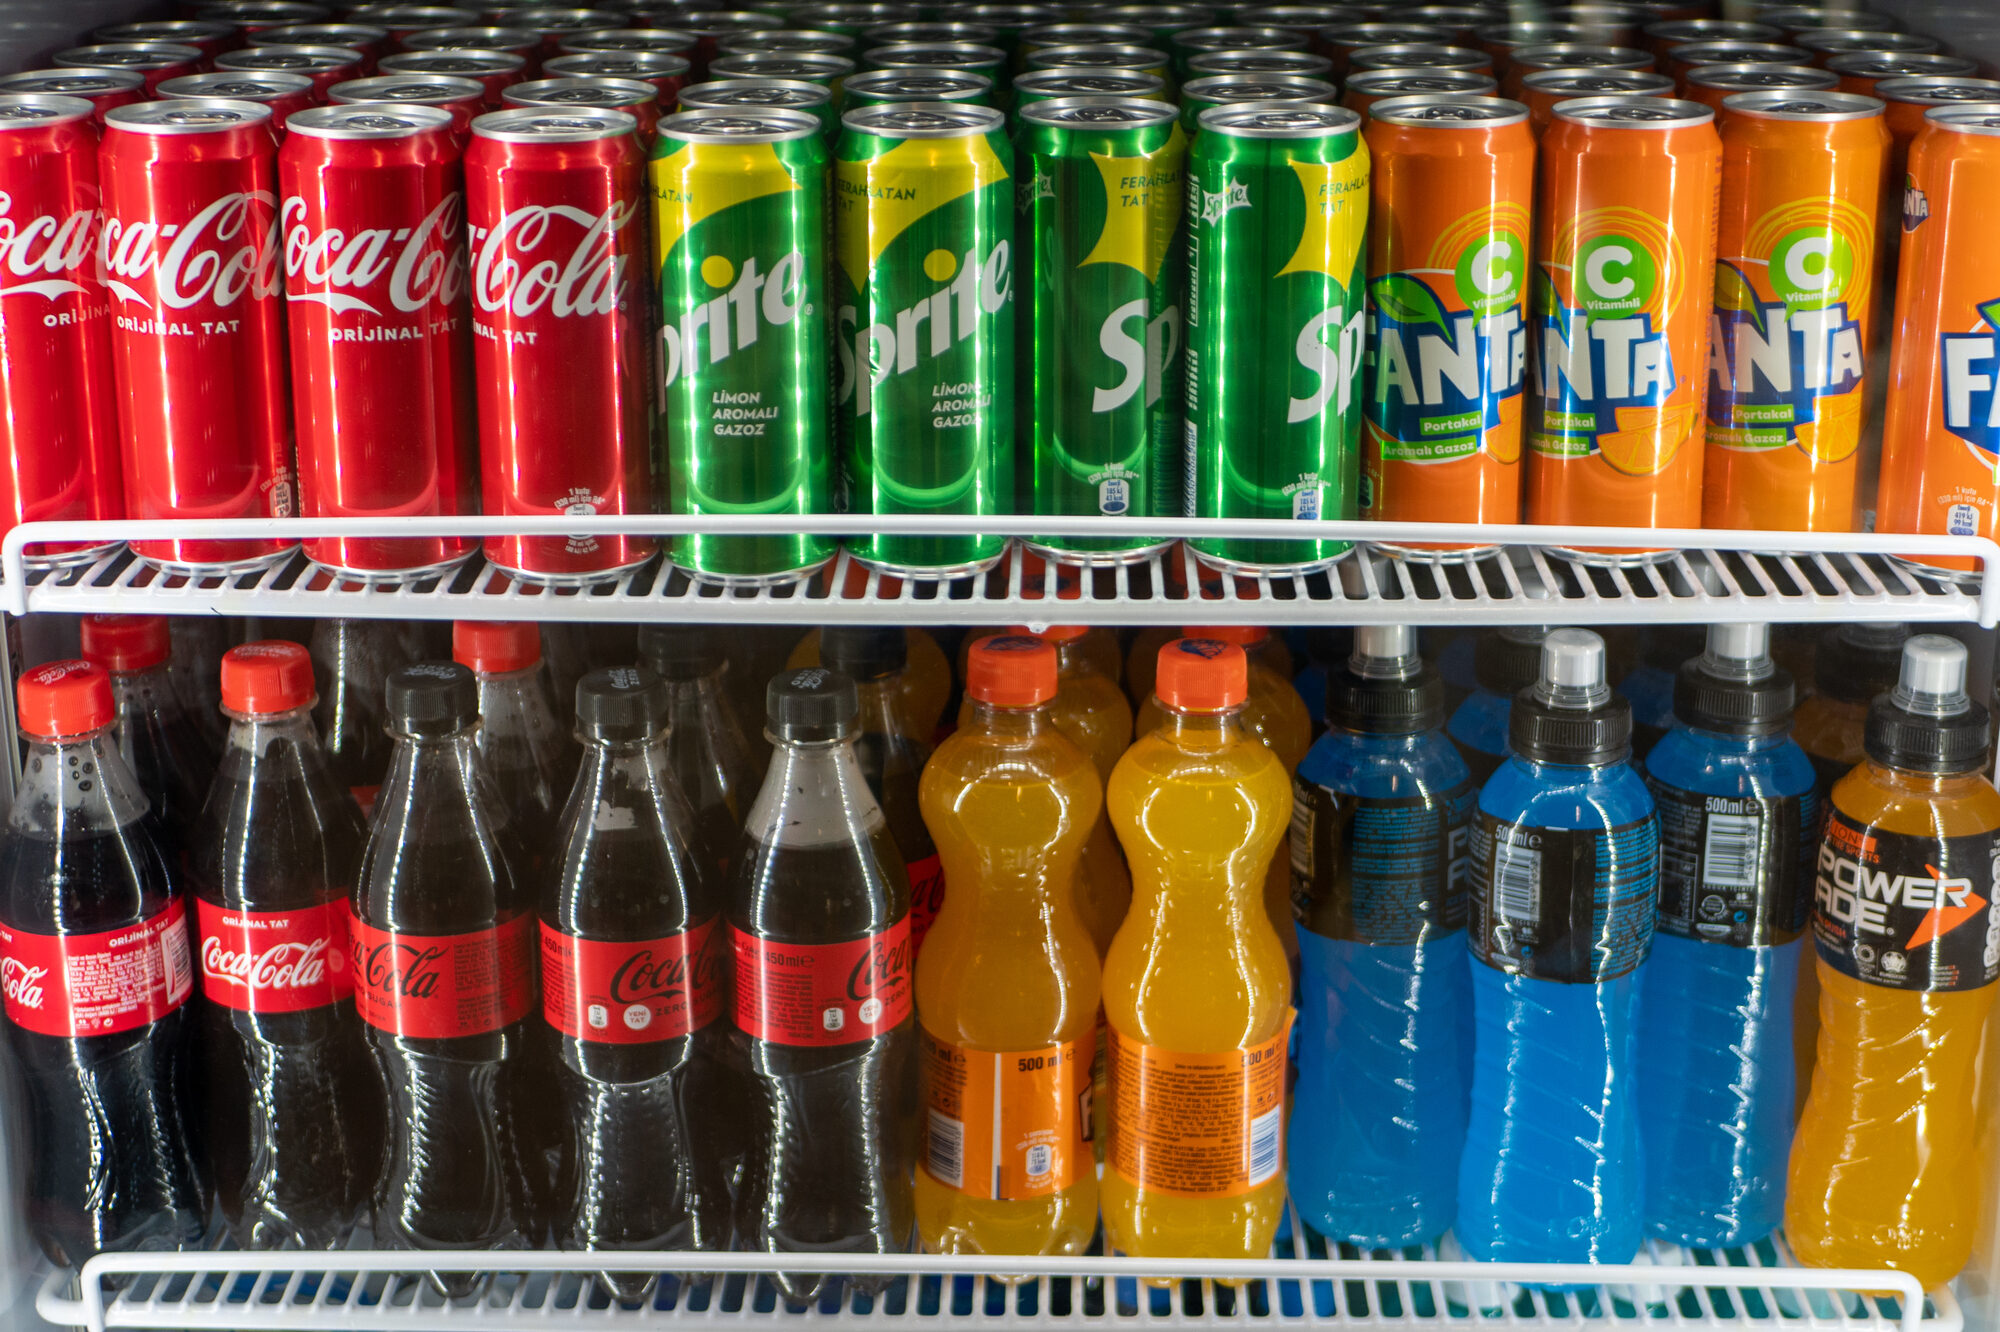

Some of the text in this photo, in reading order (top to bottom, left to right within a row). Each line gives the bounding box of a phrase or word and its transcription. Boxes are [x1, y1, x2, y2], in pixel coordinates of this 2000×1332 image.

[1121, 193, 1149, 207] TAT
[1471, 241, 1513, 295] C
[1785, 236, 1834, 290] C
[1585, 245, 1635, 299] C
[1786, 286, 1839, 303] Vitaminli
[1586, 297, 1641, 311] Vitaminli
[117, 315, 239, 336] ORİJİNAL TAT
[331, 318, 458, 342] ORİJİNAL TAT
[657, 251, 807, 415] prite
[502, 329, 537, 344] TAT
[712, 389, 761, 404] LİMON
[932, 382, 981, 397] LİMON
[712, 406, 779, 420] AROMALI
[1736, 408, 1792, 420] Portakal
[1423, 415, 1482, 432] Portakal
[1545, 415, 1595, 428] Portakal
[713, 423, 766, 436] GAZOZ
[1552, 440, 1586, 451] Gazoz
[1744, 432, 1784, 444] Gazoz
[1434, 441, 1475, 455] Gazoz
[1705, 796, 1743, 814] 500ml
[1817, 843, 1972, 909] POWER
[269, 919, 289, 928] TAT
[202, 936, 331, 989] Coca-Cola
[786, 955, 800, 967] ml
[1, 956, 48, 1009] Cola
[1018, 1056, 1044, 1072] 500
[1047, 1052, 1062, 1067] ml
